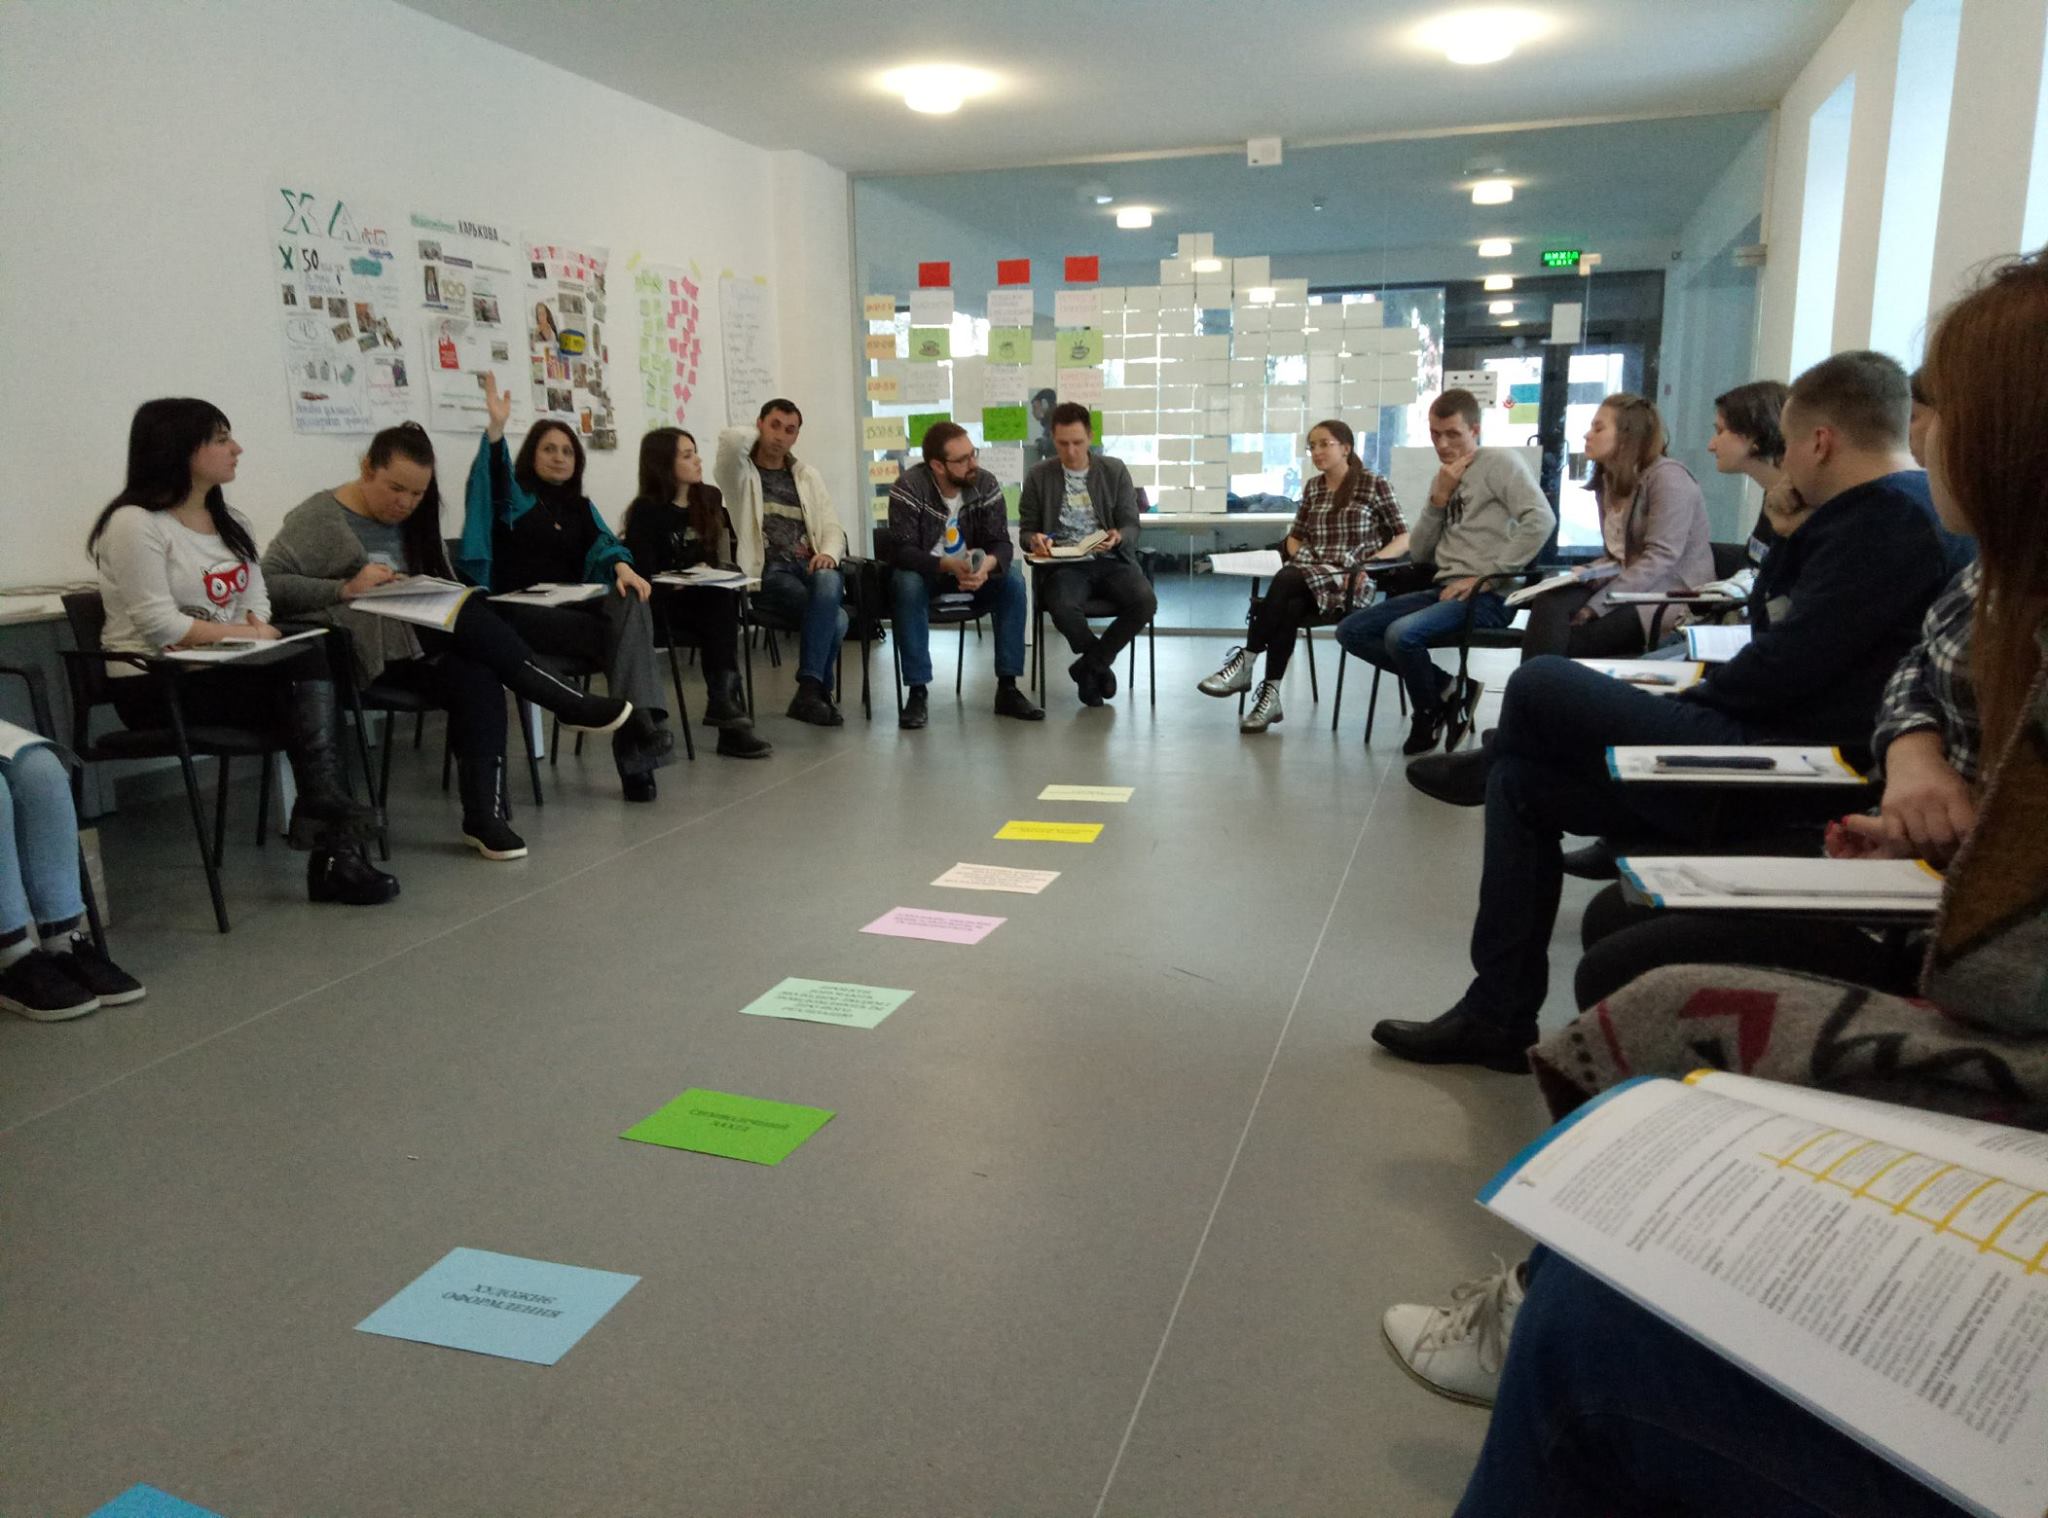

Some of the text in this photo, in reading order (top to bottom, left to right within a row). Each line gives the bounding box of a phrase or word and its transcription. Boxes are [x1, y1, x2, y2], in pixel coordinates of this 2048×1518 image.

[458, 219, 499, 241] ХАРЬКОВА
[301, 247, 319, 273] 50
[441, 1291, 564, 1318] ОФОРМЛЕННЯ
